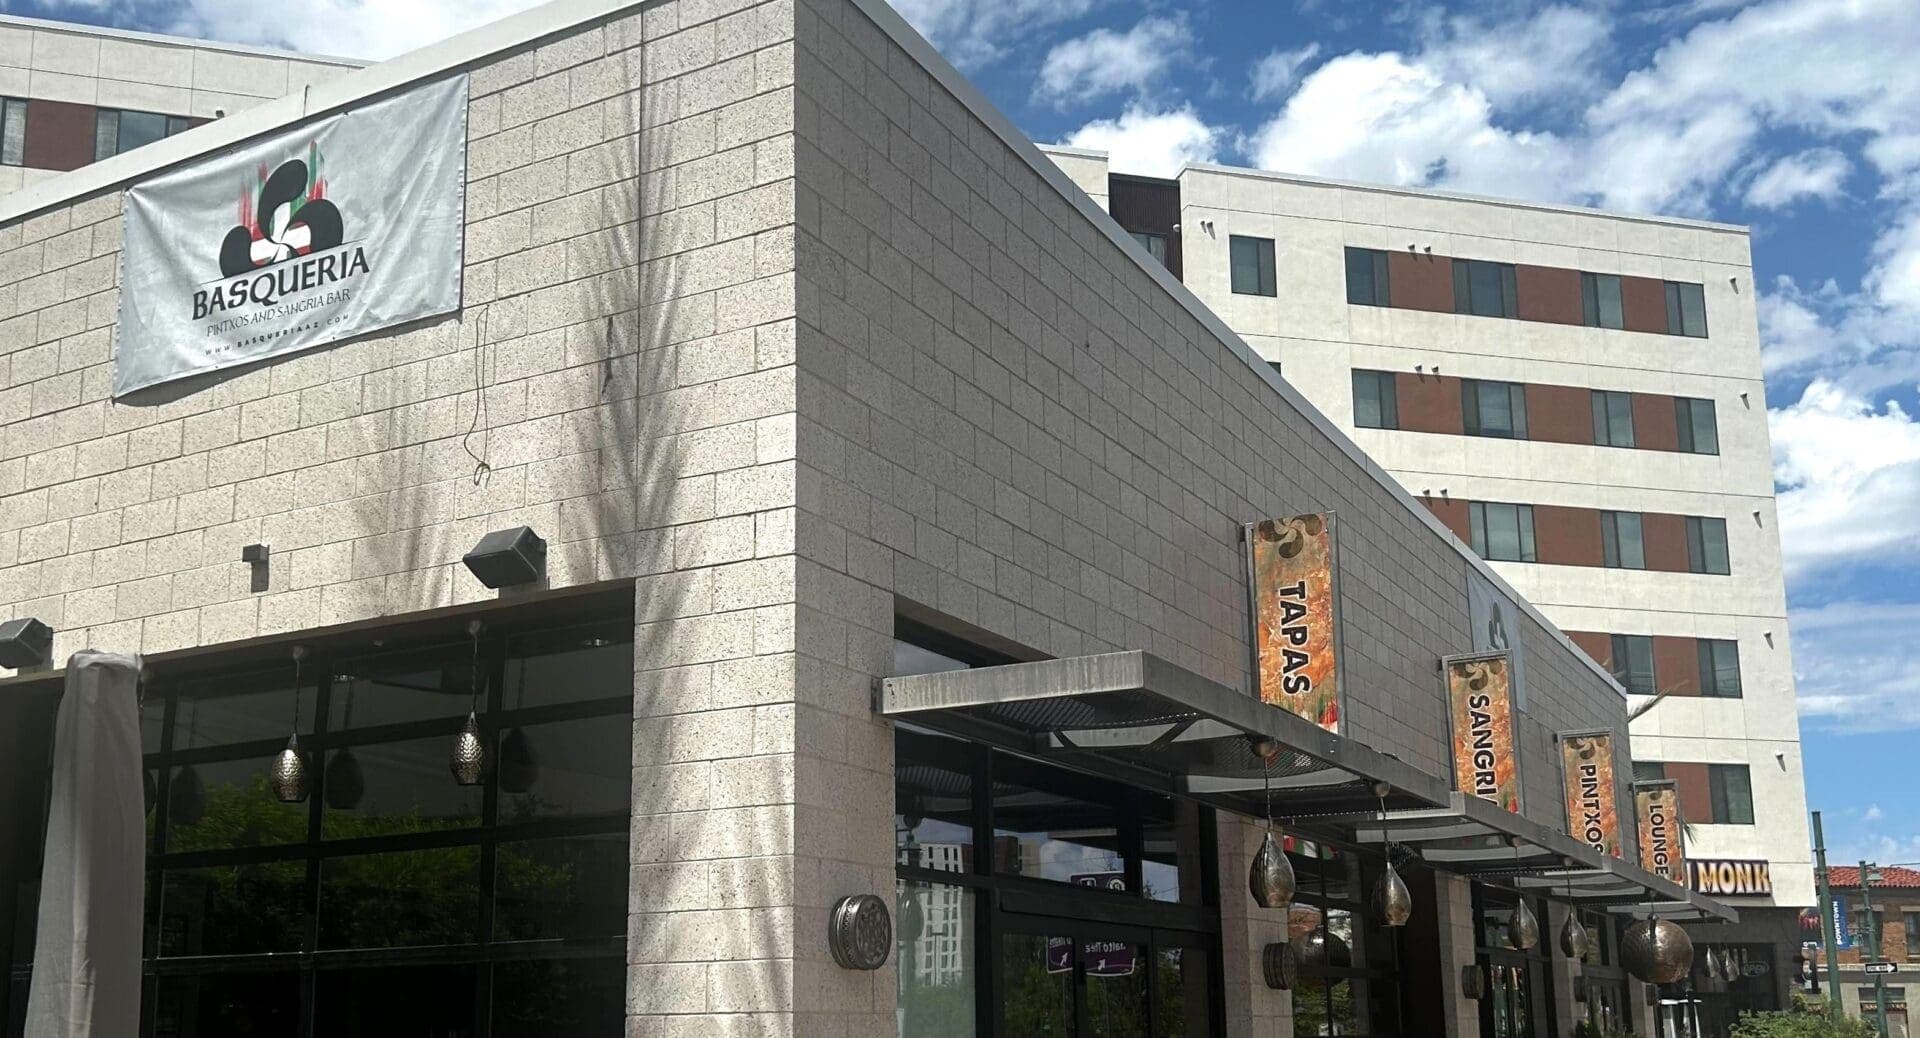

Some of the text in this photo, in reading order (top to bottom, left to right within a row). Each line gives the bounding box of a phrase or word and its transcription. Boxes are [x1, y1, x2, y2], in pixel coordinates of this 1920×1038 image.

[192, 247, 370, 320] BASQUERIA
[206, 288, 351, 337] PINTXOS AND SANGRIA BAR
[1279, 580, 1311, 695] TAPAS
[1468, 694, 1499, 807] SANGRI
[1650, 804, 1669, 876] LOUNGE
[1697, 861, 1772, 894] MONK
[1832, 901, 1843, 946] DOWNTOWN
